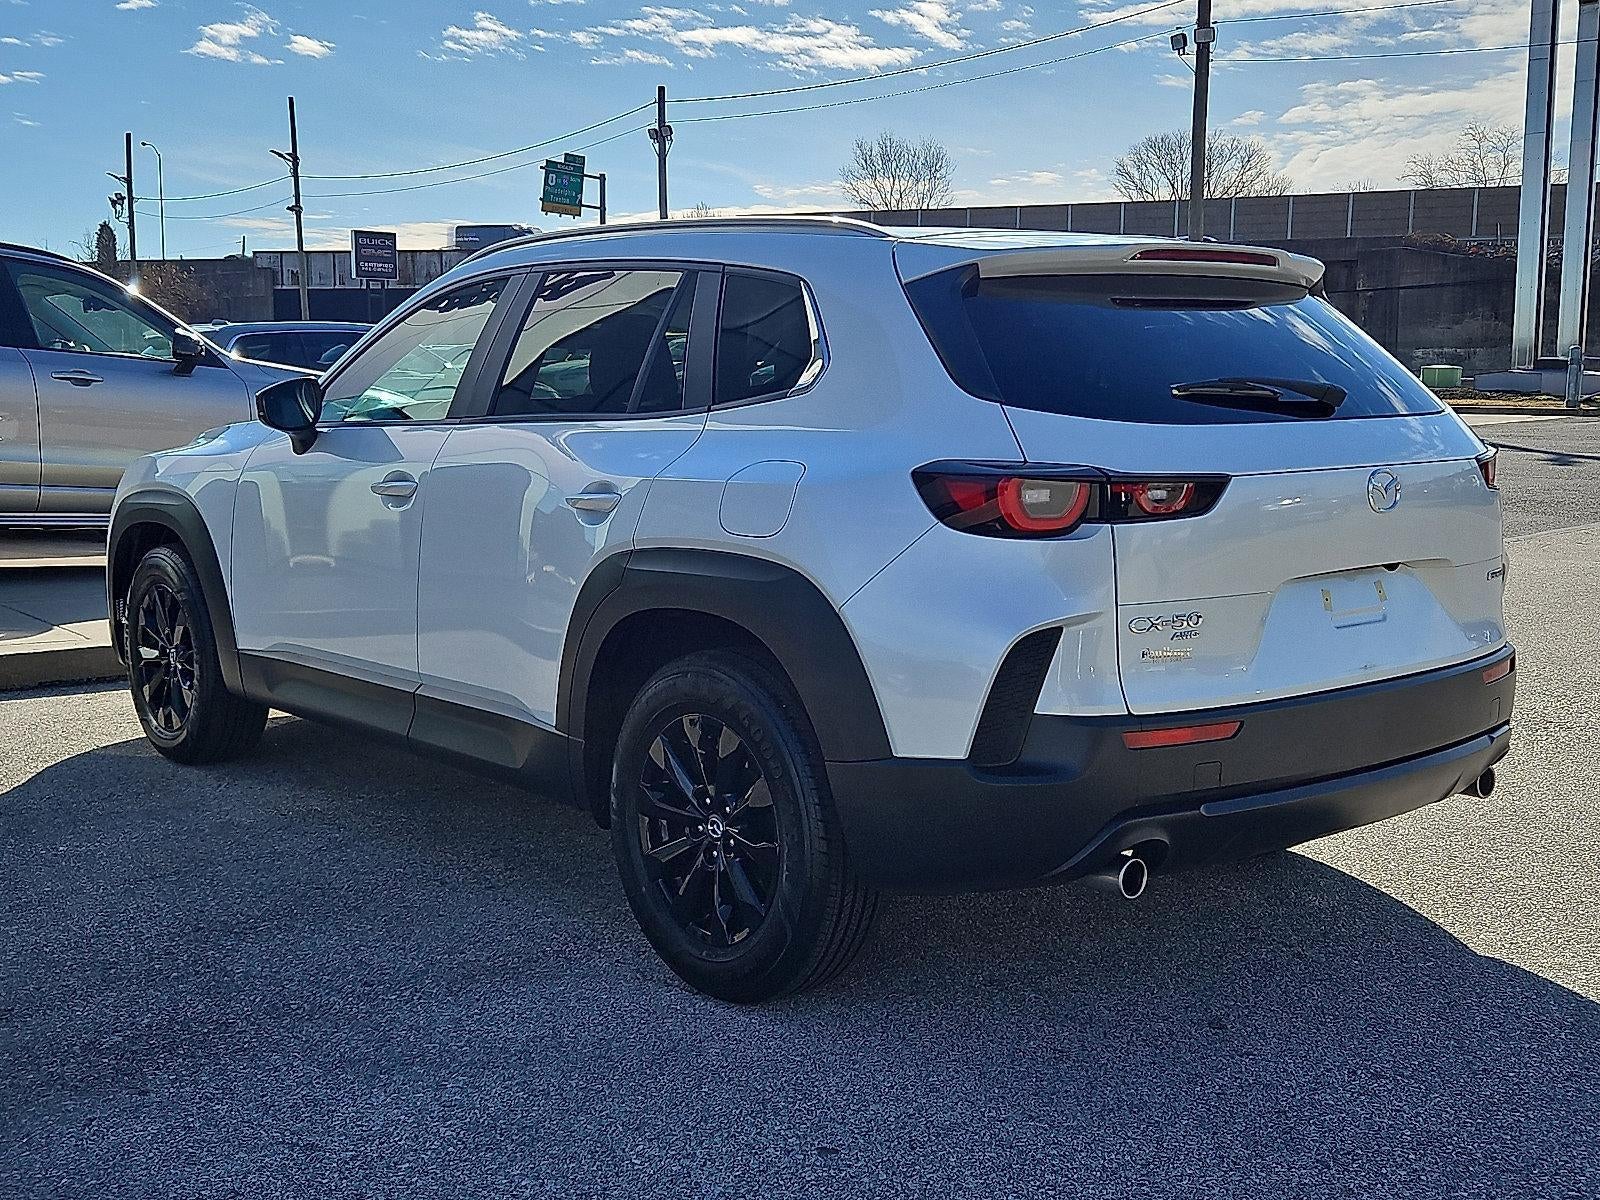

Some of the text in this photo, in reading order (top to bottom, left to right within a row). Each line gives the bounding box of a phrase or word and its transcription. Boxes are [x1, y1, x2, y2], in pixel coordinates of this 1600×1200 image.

[550, 195, 570, 204] Trenton
[358, 237, 393, 246] BUICK
[359, 261, 394, 269] CERTIFIED
[1128, 611, 1204, 634] CX-50
[1171, 629, 1200, 641] AWD
